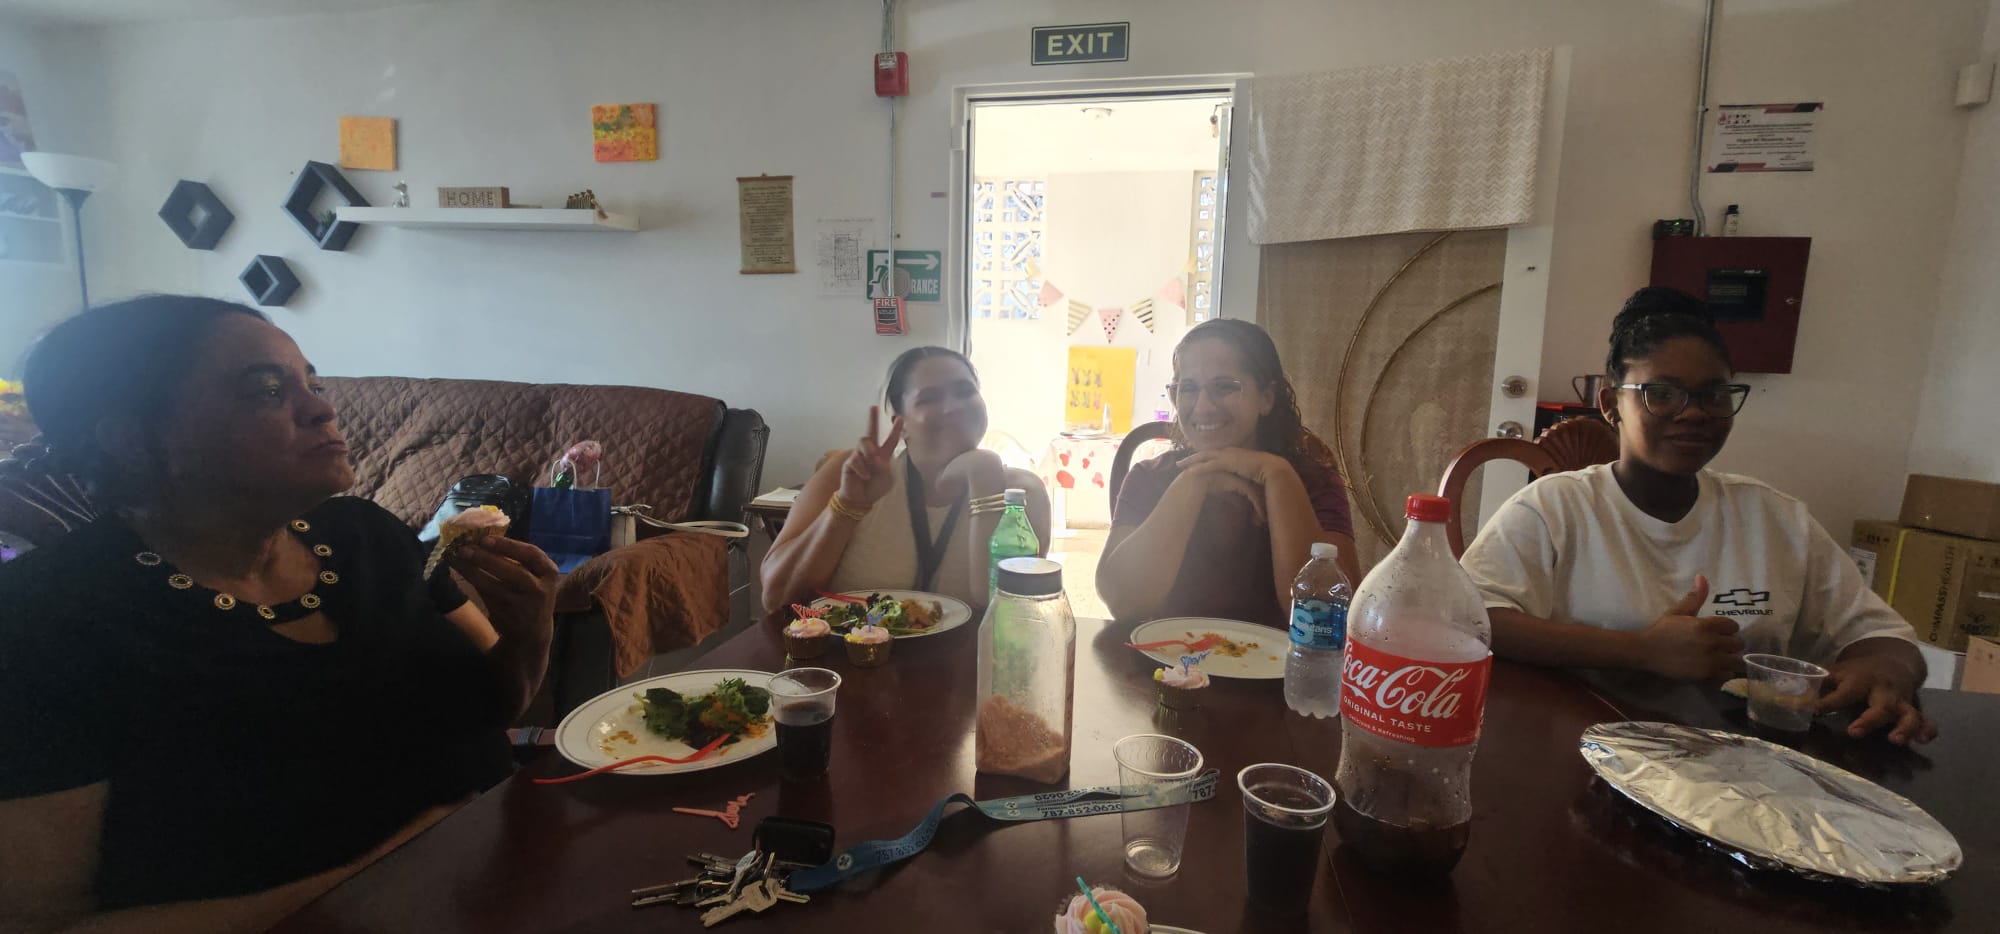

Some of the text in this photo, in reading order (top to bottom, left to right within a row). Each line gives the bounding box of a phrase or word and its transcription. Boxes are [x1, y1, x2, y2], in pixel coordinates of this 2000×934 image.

[1047, 31, 1114, 56] EXIT
[446, 191, 494, 206] HOME
[911, 279, 939, 295] RANCE
[875, 298, 897, 307] FIRE
[1343, 642, 1472, 719] Coca-Cola
[1344, 695, 1432, 733] ORIGINAL TASTE
[1042, 803, 1121, 818] 787-852-0620
